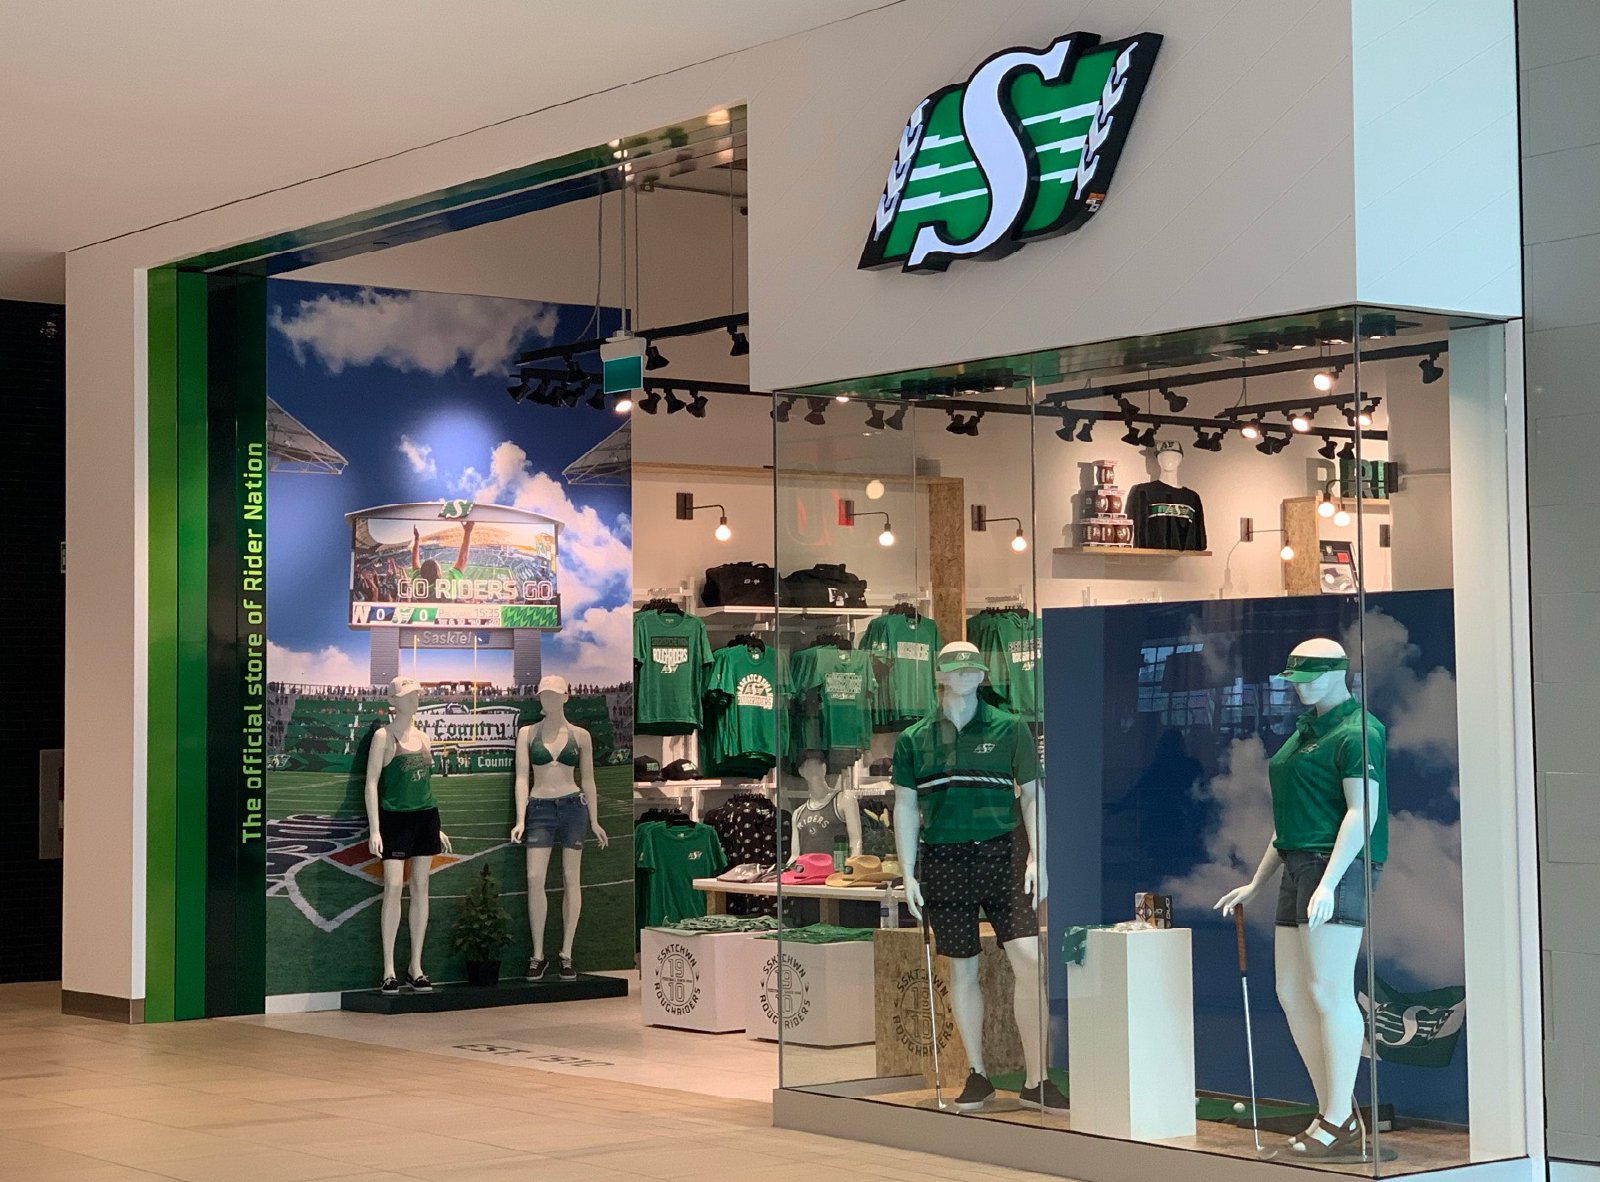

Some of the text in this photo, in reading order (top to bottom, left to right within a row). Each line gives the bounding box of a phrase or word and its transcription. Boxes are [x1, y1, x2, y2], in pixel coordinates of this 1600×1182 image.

[397, 578, 553, 601] GO RIDERS GO
[242, 442, 263, 844] The official store of Rider Nation
[422, 630, 474, 645] SaskTel
[434, 718, 506, 737] Country
[477, 756, 515, 768] Countr
[797, 814, 830, 829] RIDERS
[763, 953, 806, 978] SSKCHWN
[760, 994, 811, 1029] ROUGRIDERS
